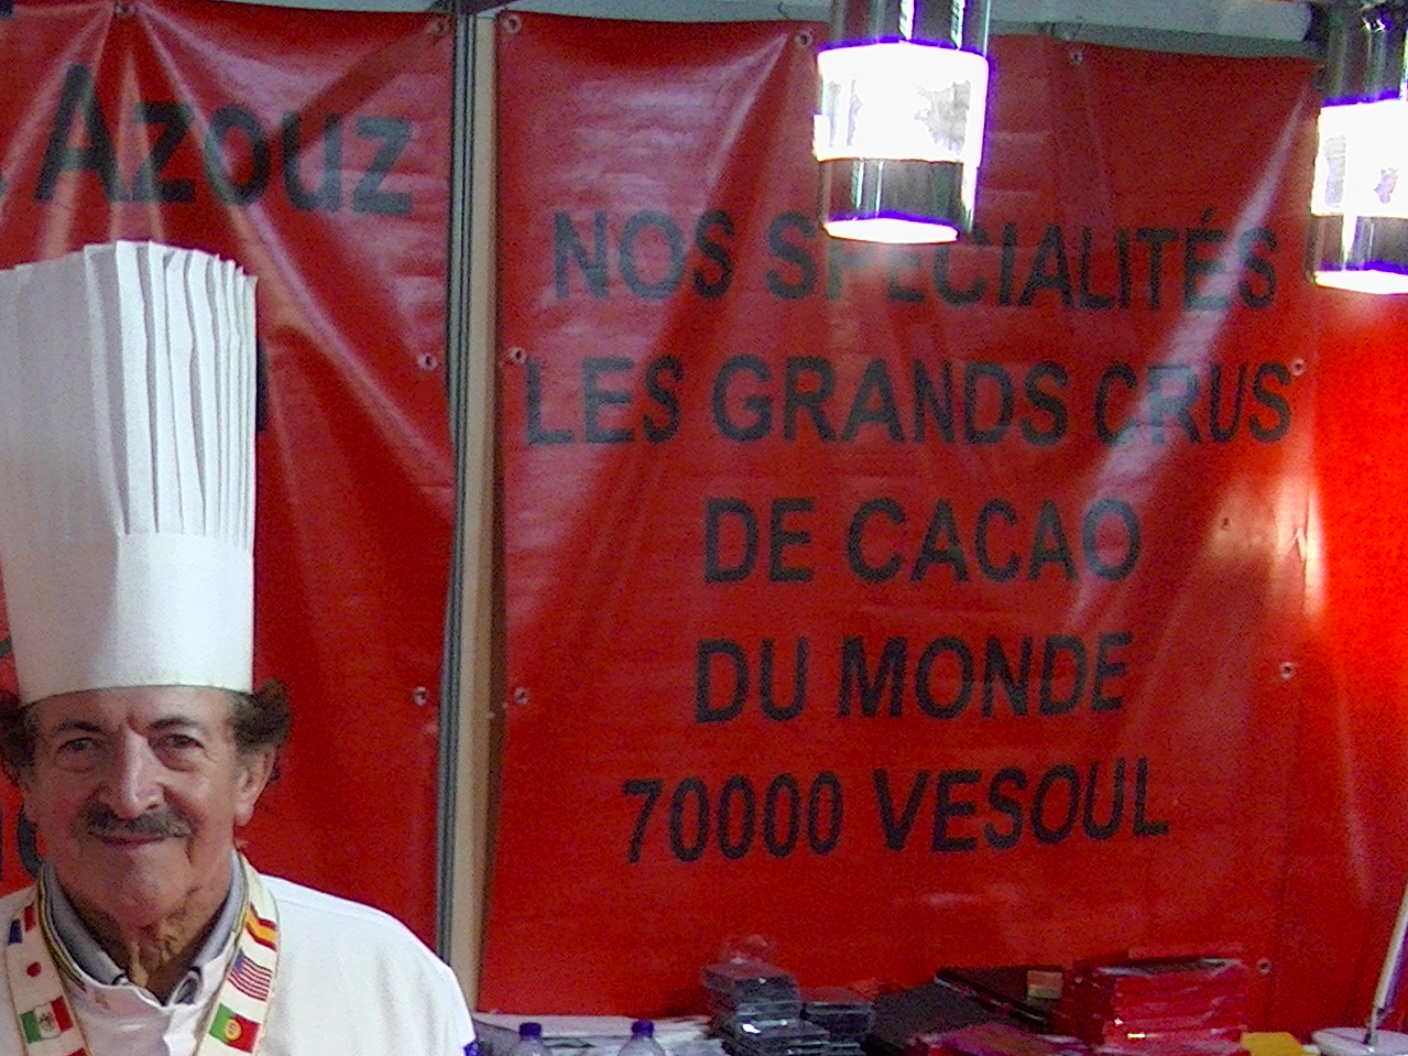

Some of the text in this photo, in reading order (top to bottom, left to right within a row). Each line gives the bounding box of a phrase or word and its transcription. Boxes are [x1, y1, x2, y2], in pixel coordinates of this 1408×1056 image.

[33, 63, 414, 215] Azouz
[552, 209, 735, 300] NOS
[526, 353, 1292, 447] LES GRANDS CRUS
[703, 496, 1142, 584] DE CACAO
[694, 632, 1133, 723] DU MONDE
[622, 757, 1169, 864] 70000 VESOUL
